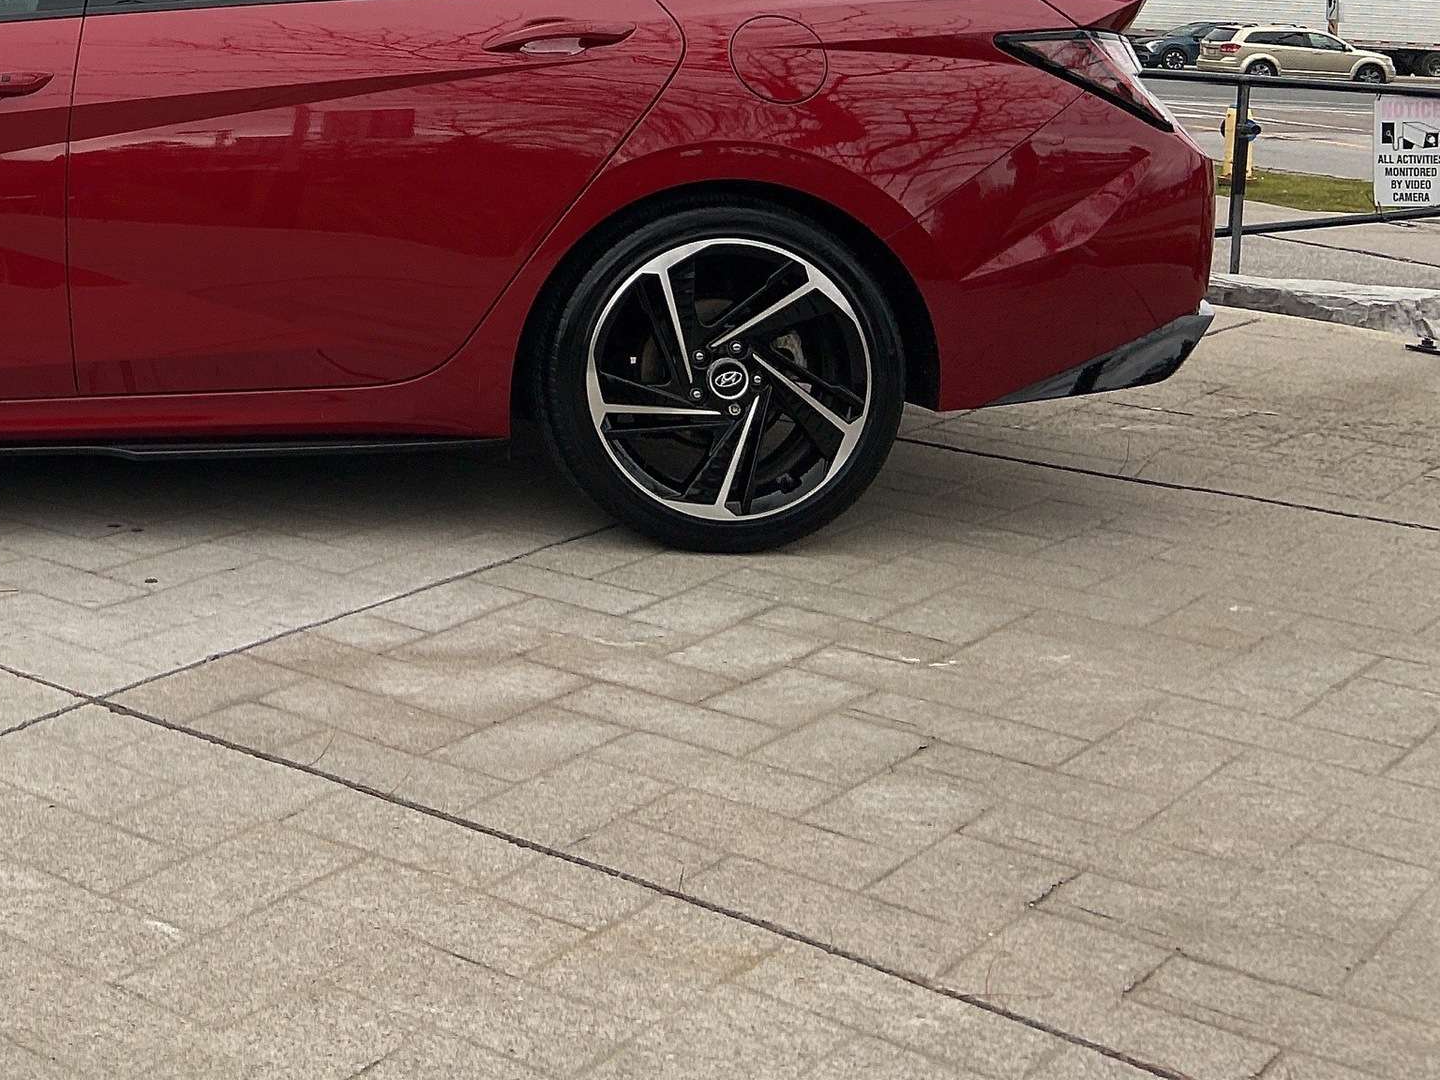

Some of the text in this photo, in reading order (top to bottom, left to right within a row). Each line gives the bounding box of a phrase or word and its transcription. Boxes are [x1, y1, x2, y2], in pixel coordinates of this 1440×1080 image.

[1378, 154, 1394, 165] ALL
[1385, 167, 1437, 177] MONITORED
[1391, 180, 1432, 190] BY VIDEO
[1393, 192, 1430, 202] CAMERA
